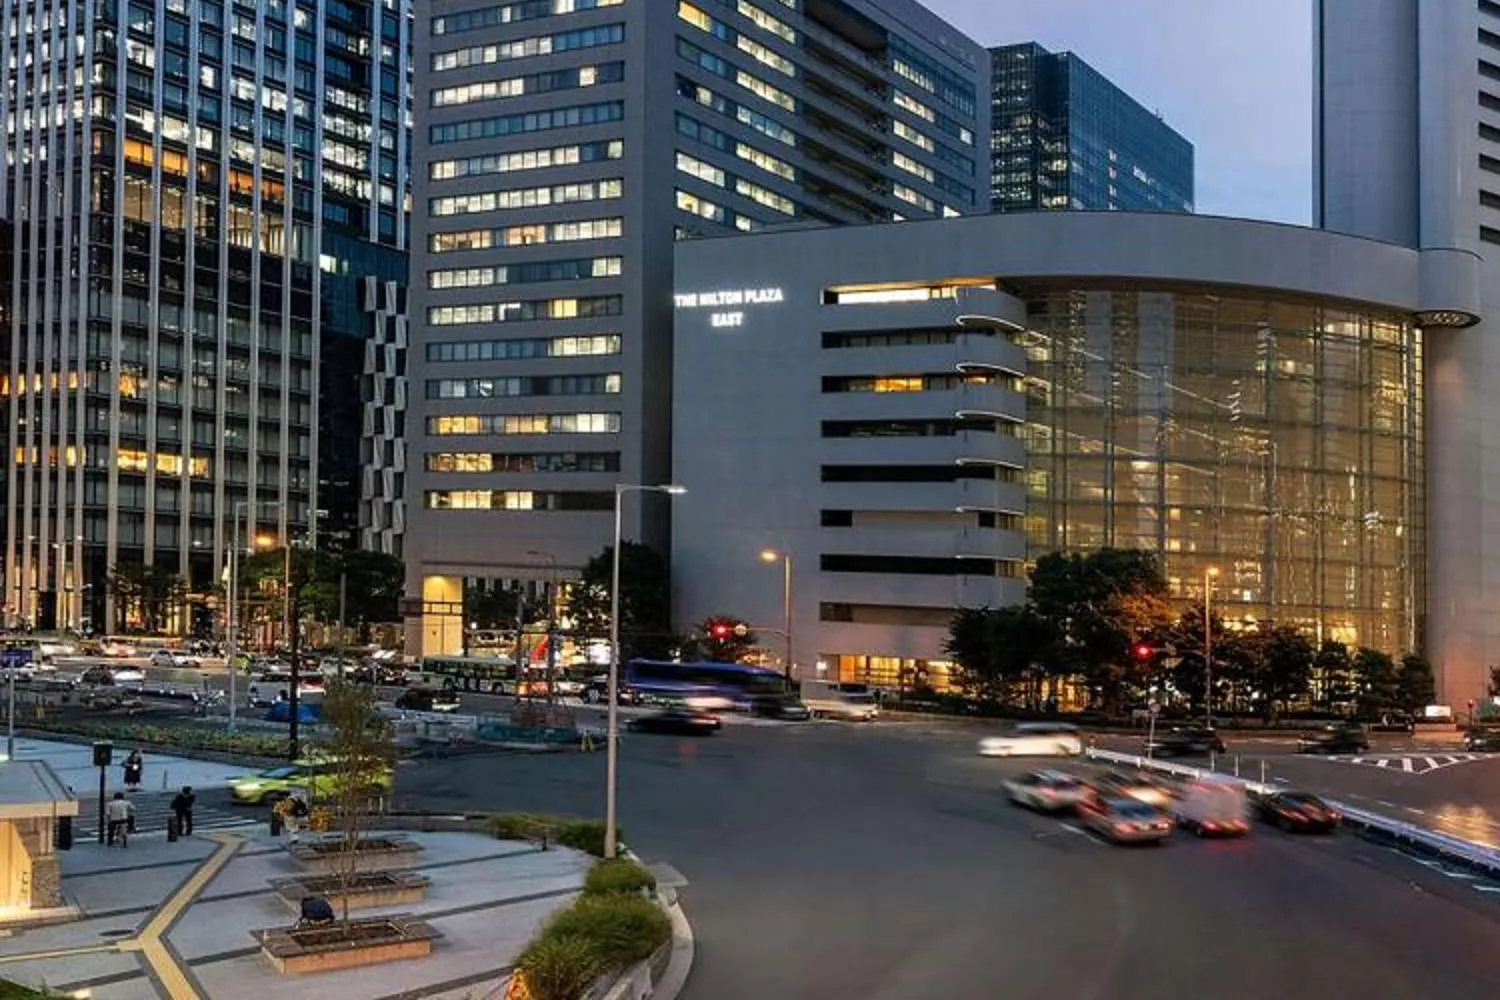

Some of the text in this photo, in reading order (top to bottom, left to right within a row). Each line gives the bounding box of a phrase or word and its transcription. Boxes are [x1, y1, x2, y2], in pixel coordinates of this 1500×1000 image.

[700, 290, 743, 307] HILTON
[745, 286, 785, 303] PLAZA
[711, 311, 744, 328] EAST
